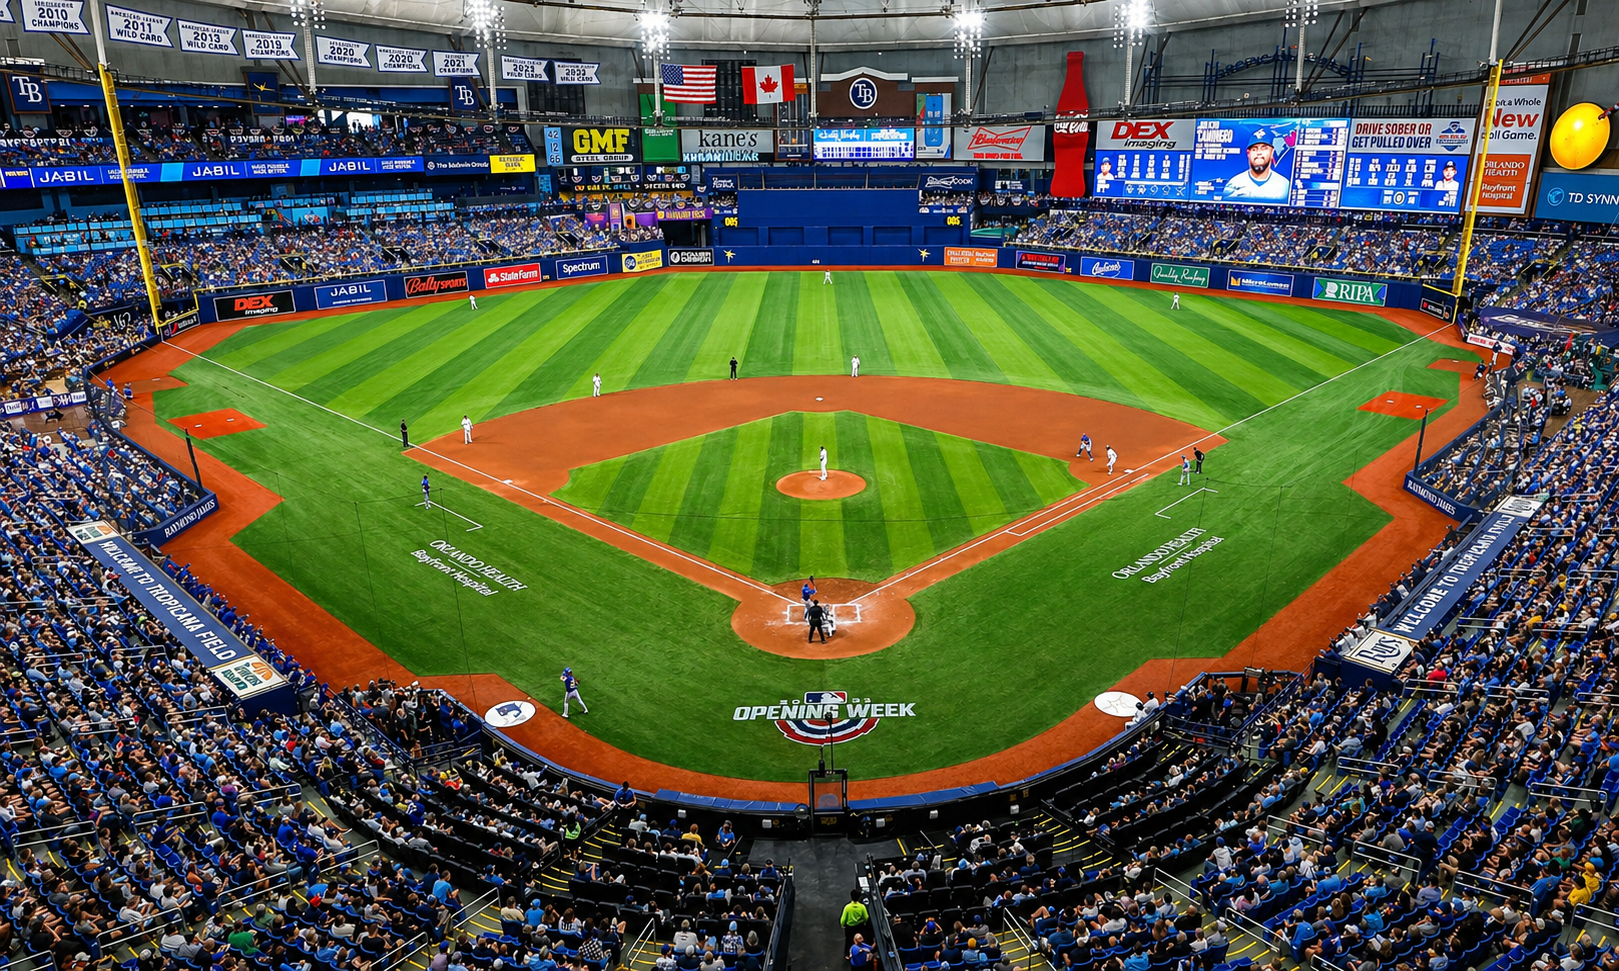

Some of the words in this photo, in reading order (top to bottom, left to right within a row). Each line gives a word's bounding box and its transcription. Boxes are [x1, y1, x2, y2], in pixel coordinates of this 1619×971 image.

[38, 8, 68, 20] 2010
[124, 19, 152, 33] 2011
[115, 28, 138, 39] WILD
[193, 31, 220, 43] 2013
[256, 39, 282, 50] 2019
[330, 46, 355, 57] 2020
[388, 54, 414, 64] 2020
[443, 59, 466, 68] 2021
[1514, 98, 1541, 106] Whole
[547, 130, 559, 138] 42
[1111, 121, 1175, 140] DEX
[1355, 122, 1385, 135] DRIVE
[1385, 123, 1417, 135] SOBER
[1417, 123, 1432, 135] OR
[572, 128, 630, 154] GMF
[697, 129, 759, 148] kane's
[1501, 131, 1537, 140] Game.
[550, 143, 559, 152] 12
[1352, 136, 1370, 148] GET
[1370, 136, 1406, 149] PULLED
[1406, 136, 1431, 148] OVER
[192, 165, 240, 177] JABIL
[328, 161, 371, 172] JABIL
[40, 170, 95, 183] JABIL
[1568, 192, 1584, 203] TD
[562, 262, 600, 275] Spectrum
[330, 284, 372, 297] JABIL
[405, 276, 440, 294] Bally
[440, 277, 467, 290] SPORTS
[1338, 283, 1376, 303] RIPA
[234, 294, 275, 312] DEX
[1111, 548, 1170, 579] ORLANDO
[195, 630, 237, 661] FIELD
[733, 704, 839, 721] OPENING
[846, 702, 916, 718] WEEK
